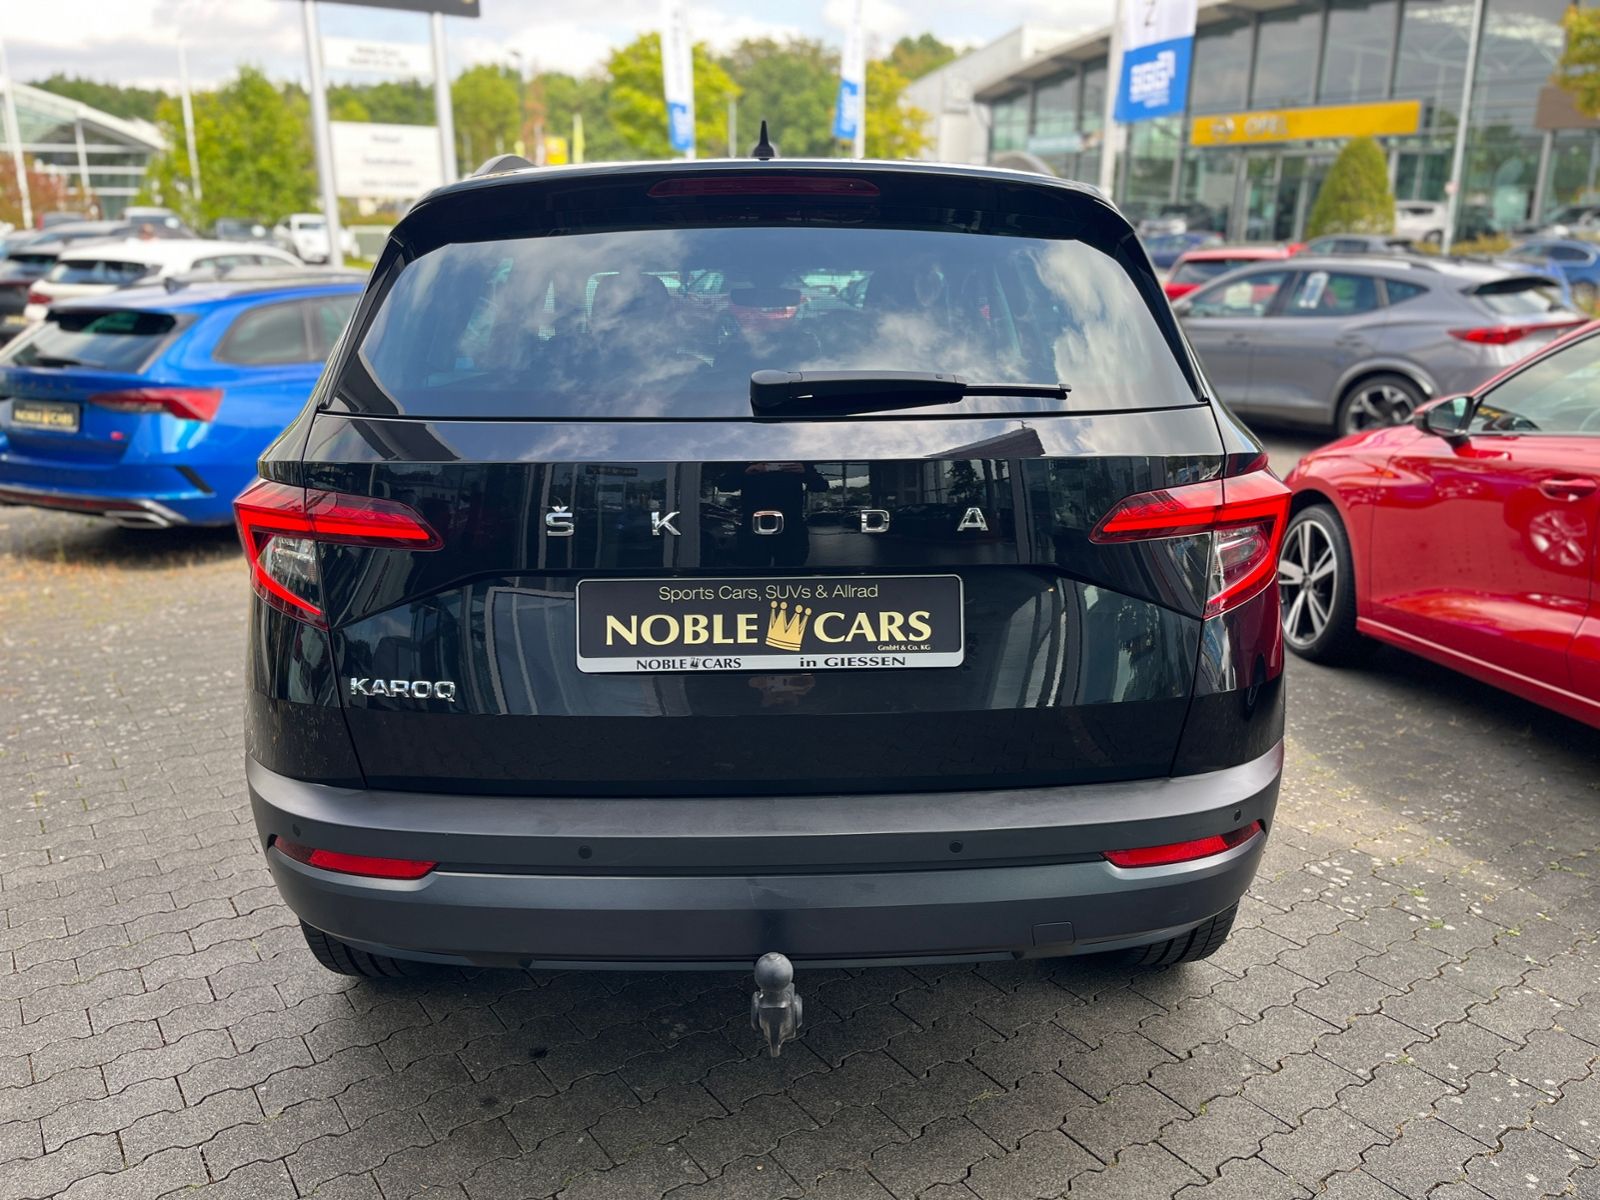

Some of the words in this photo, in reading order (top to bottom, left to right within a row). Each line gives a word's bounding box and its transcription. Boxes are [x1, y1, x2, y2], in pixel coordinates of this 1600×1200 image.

[545, 506, 989, 537] ŠKODA
[658, 586, 714, 603] Sports
[718, 585, 761, 601] Cars,
[765, 584, 811, 599] SUVs
[815, 585, 828, 598] &
[832, 584, 879, 598] Allrad
[605, 613, 758, 646] NOBLE
[813, 610, 932, 643] CARS
[636, 658, 687, 670] NOBLE
[702, 658, 742, 669] CARS
[800, 657, 817, 667] in
[824, 656, 906, 667] GIESSEN
[350, 677, 456, 702] KAROQ
